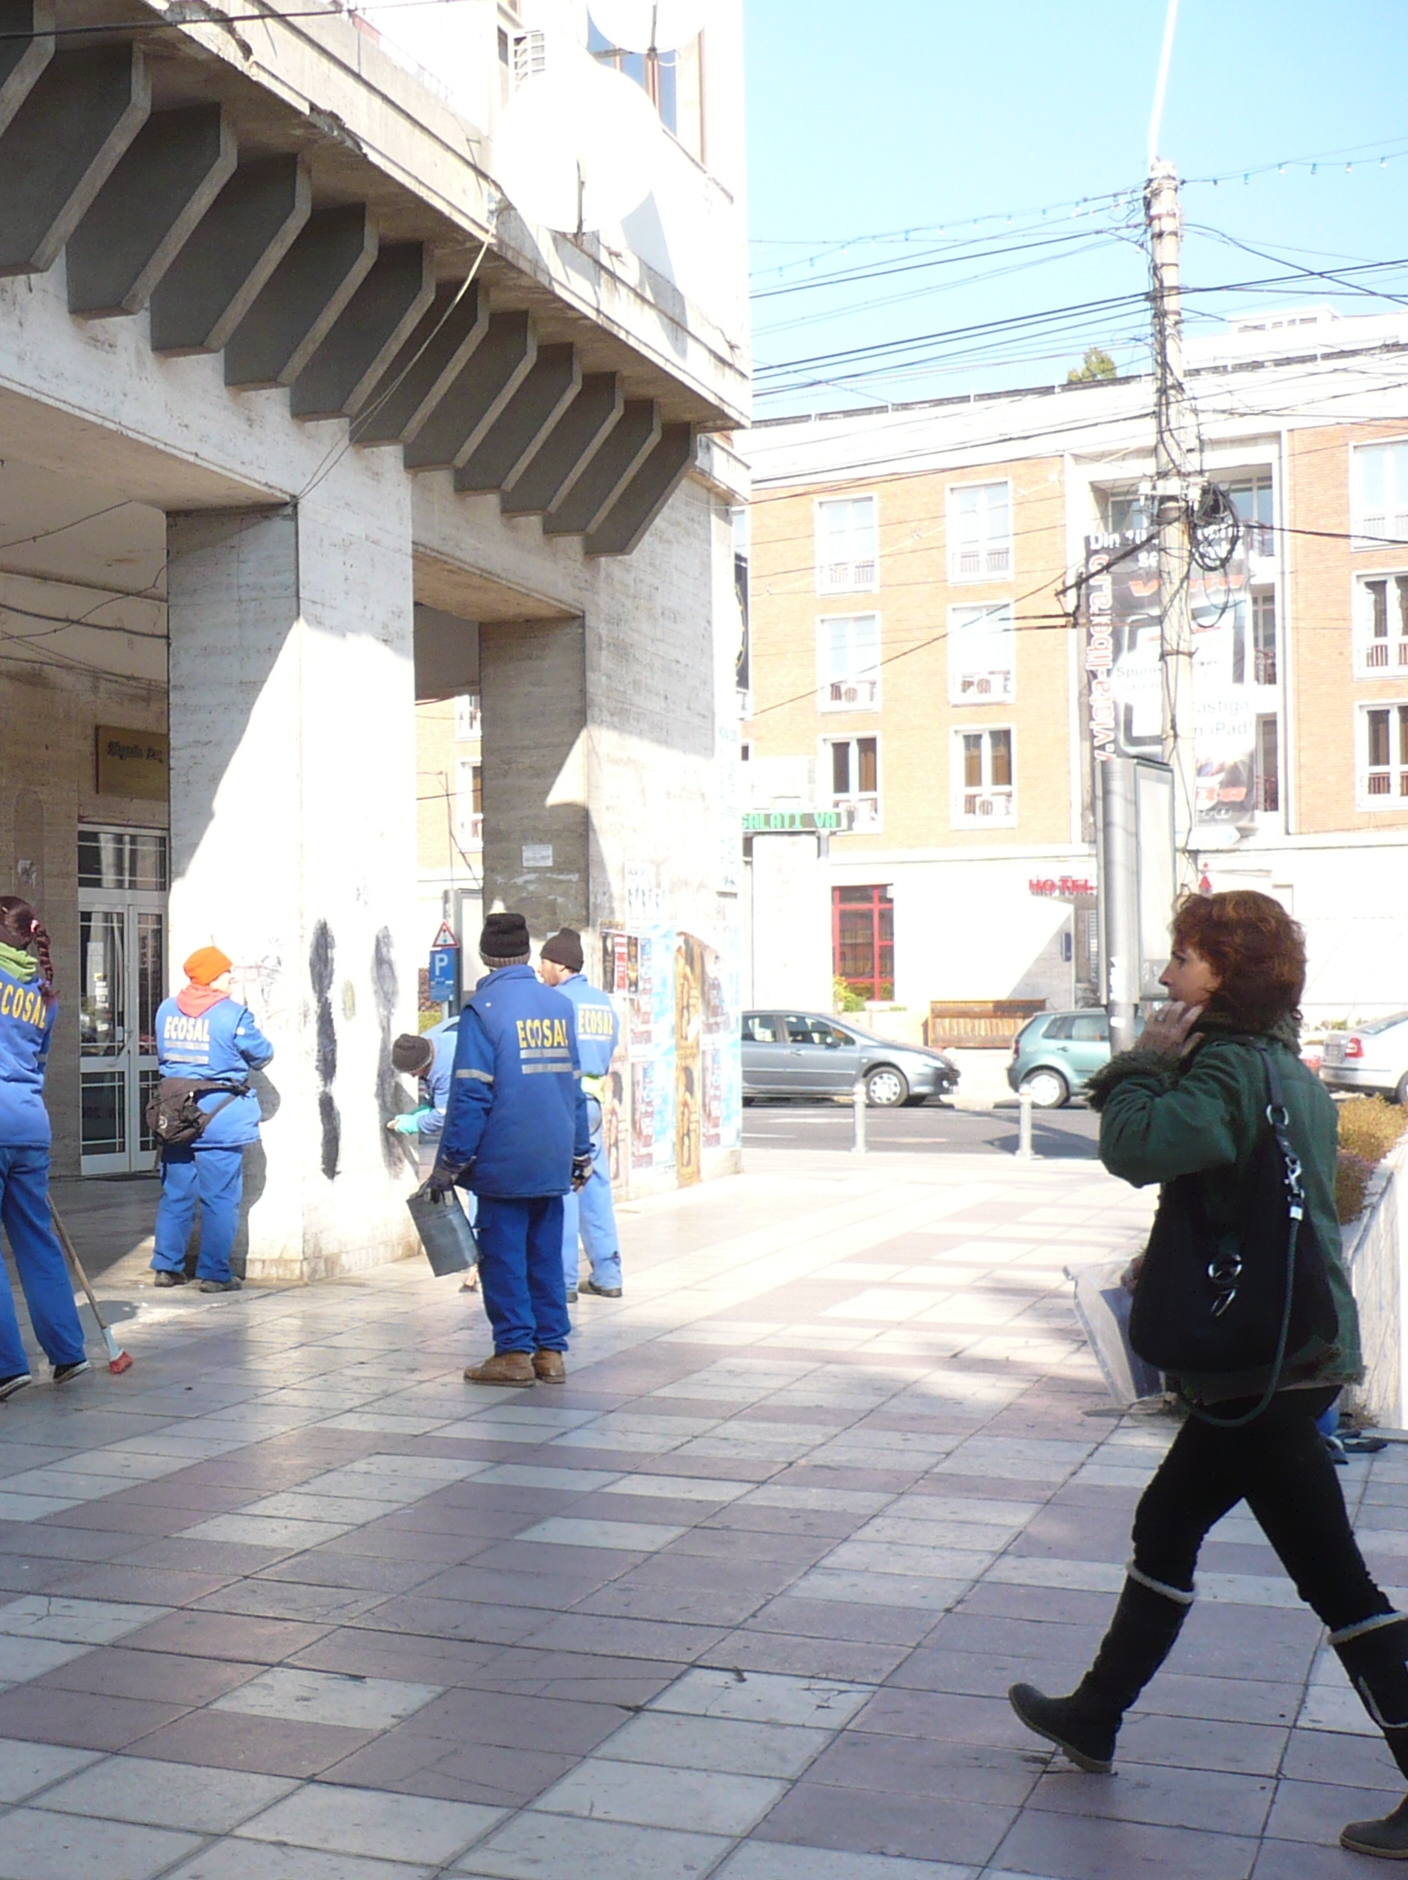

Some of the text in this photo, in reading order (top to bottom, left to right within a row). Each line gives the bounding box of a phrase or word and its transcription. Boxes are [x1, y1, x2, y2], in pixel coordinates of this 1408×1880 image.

[1029, 877, 1097, 893] HOTEL
[435, 953, 449, 976] P
[164, 1015, 211, 1042] ECOSAL
[577, 1009, 614, 1035] ECOSAL
